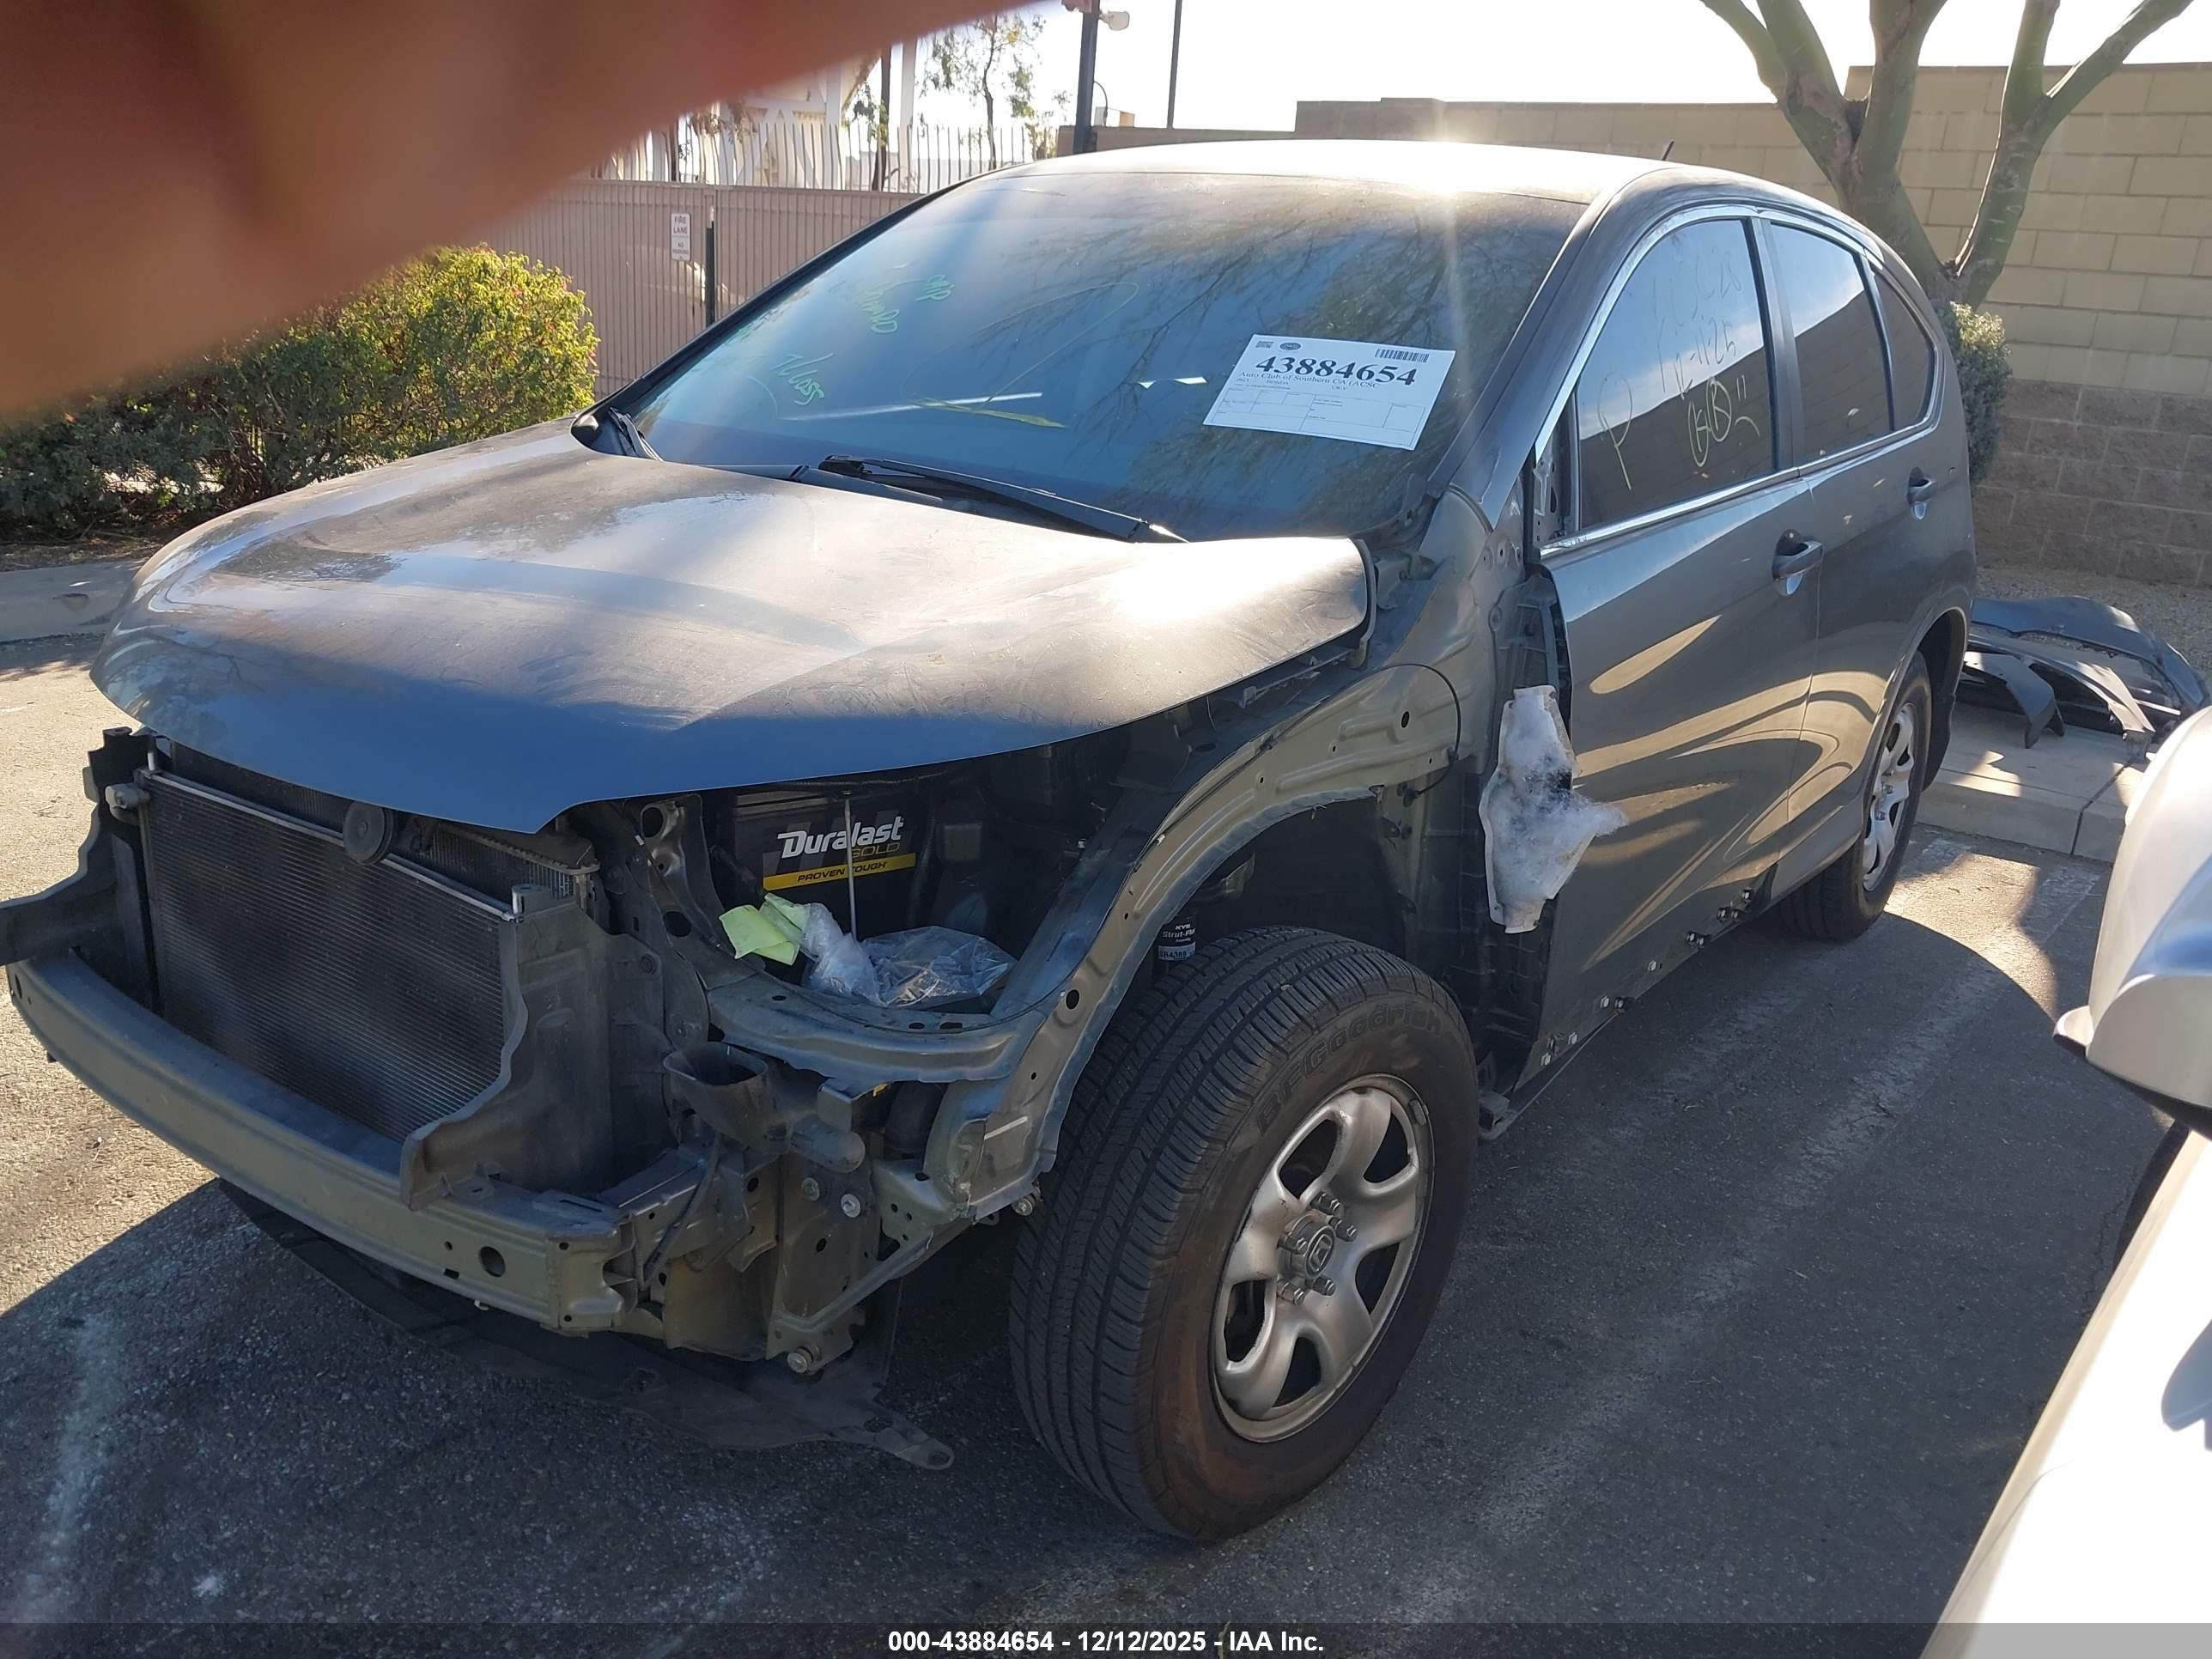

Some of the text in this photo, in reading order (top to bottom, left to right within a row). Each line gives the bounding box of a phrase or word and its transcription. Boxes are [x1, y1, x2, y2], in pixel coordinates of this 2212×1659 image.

[674, 216, 687, 224] FIRE
[673, 226, 688, 234] LANE
[1255, 356, 1418, 386] 43884654
[1294, 375, 1330, 384] Southern
[777, 816, 904, 859] Duralast
[797, 861, 887, 882] PROVEN OUGH
